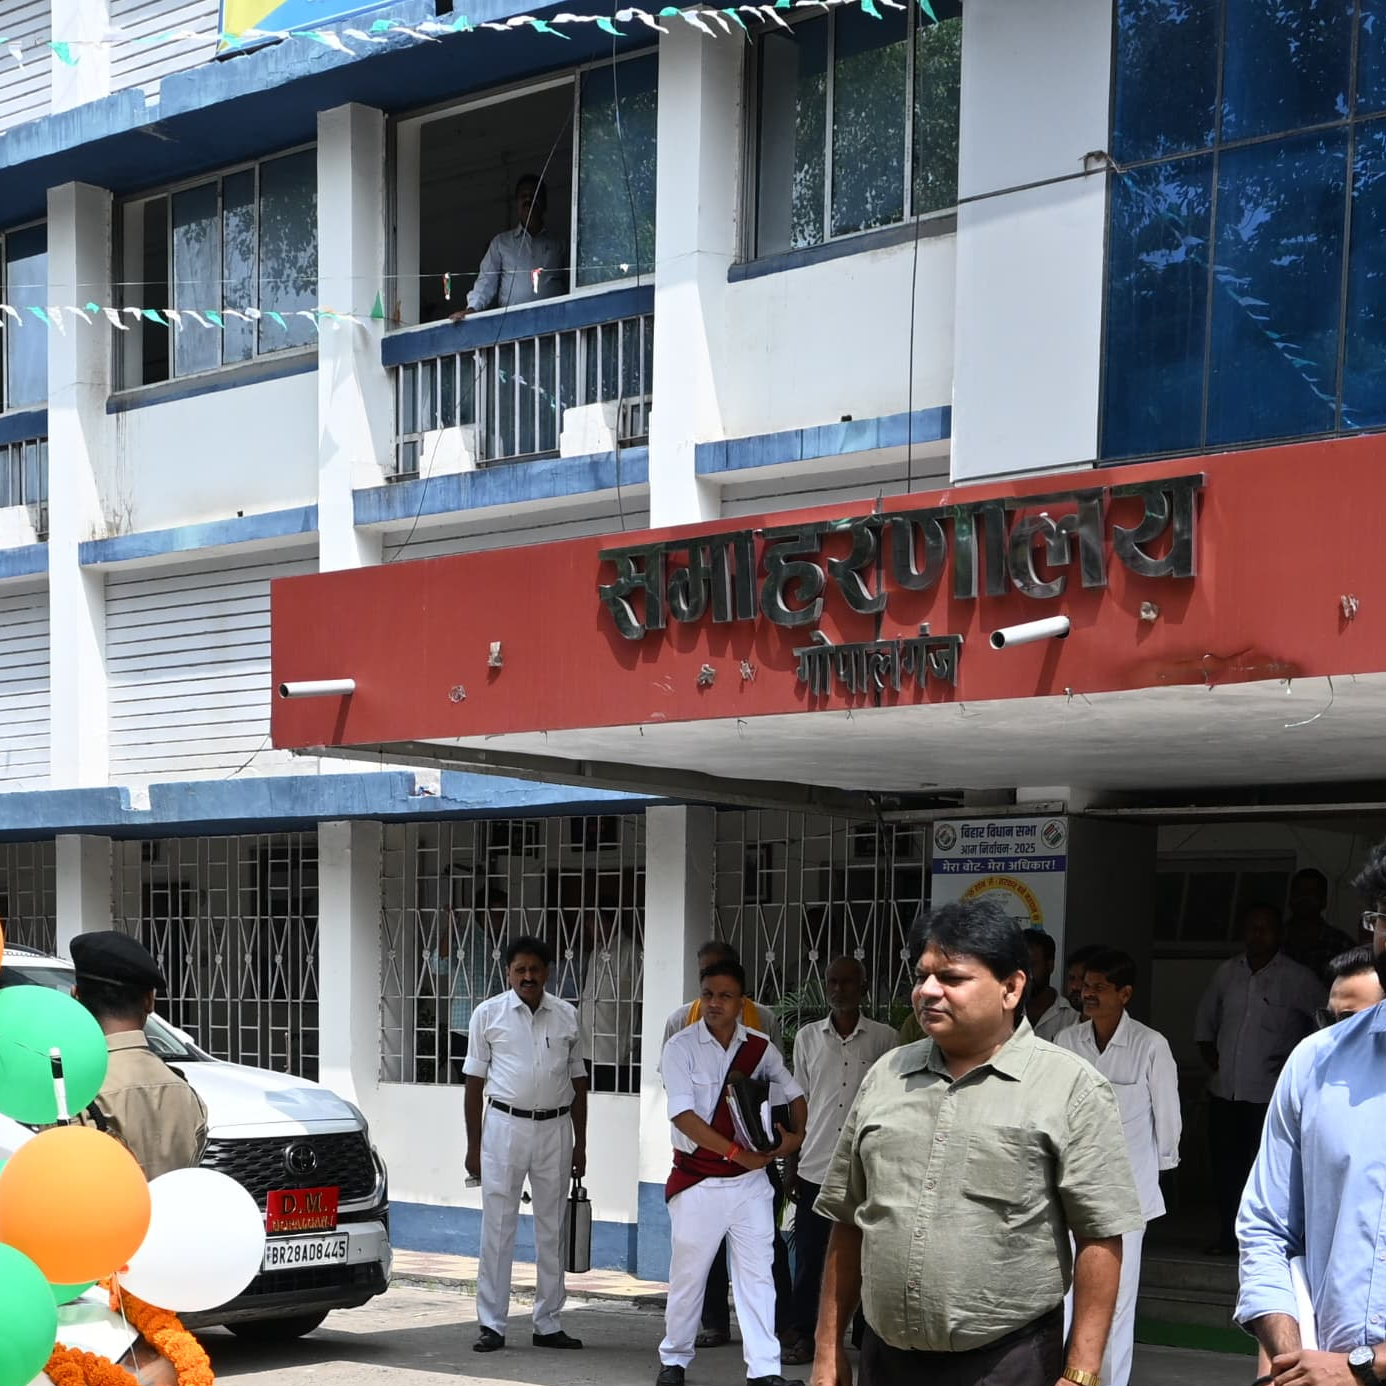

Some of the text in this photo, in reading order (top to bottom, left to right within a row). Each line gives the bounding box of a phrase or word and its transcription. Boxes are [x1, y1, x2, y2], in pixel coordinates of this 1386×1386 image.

[598, 473, 1208, 641] समाहरणालय
[793, 621, 964, 697] गोपालगंज
[961, 824, 985, 839] बिहार
[987, 823, 1013, 838] विधान
[1015, 824, 1038, 837] सभा
[960, 843, 977, 856] आम
[1014, 843, 1036, 854] 2025
[942, 859, 960, 872] मेरा
[987, 859, 1005, 872] मेरा
[272, 1240, 346, 1265] BR28AD8445
